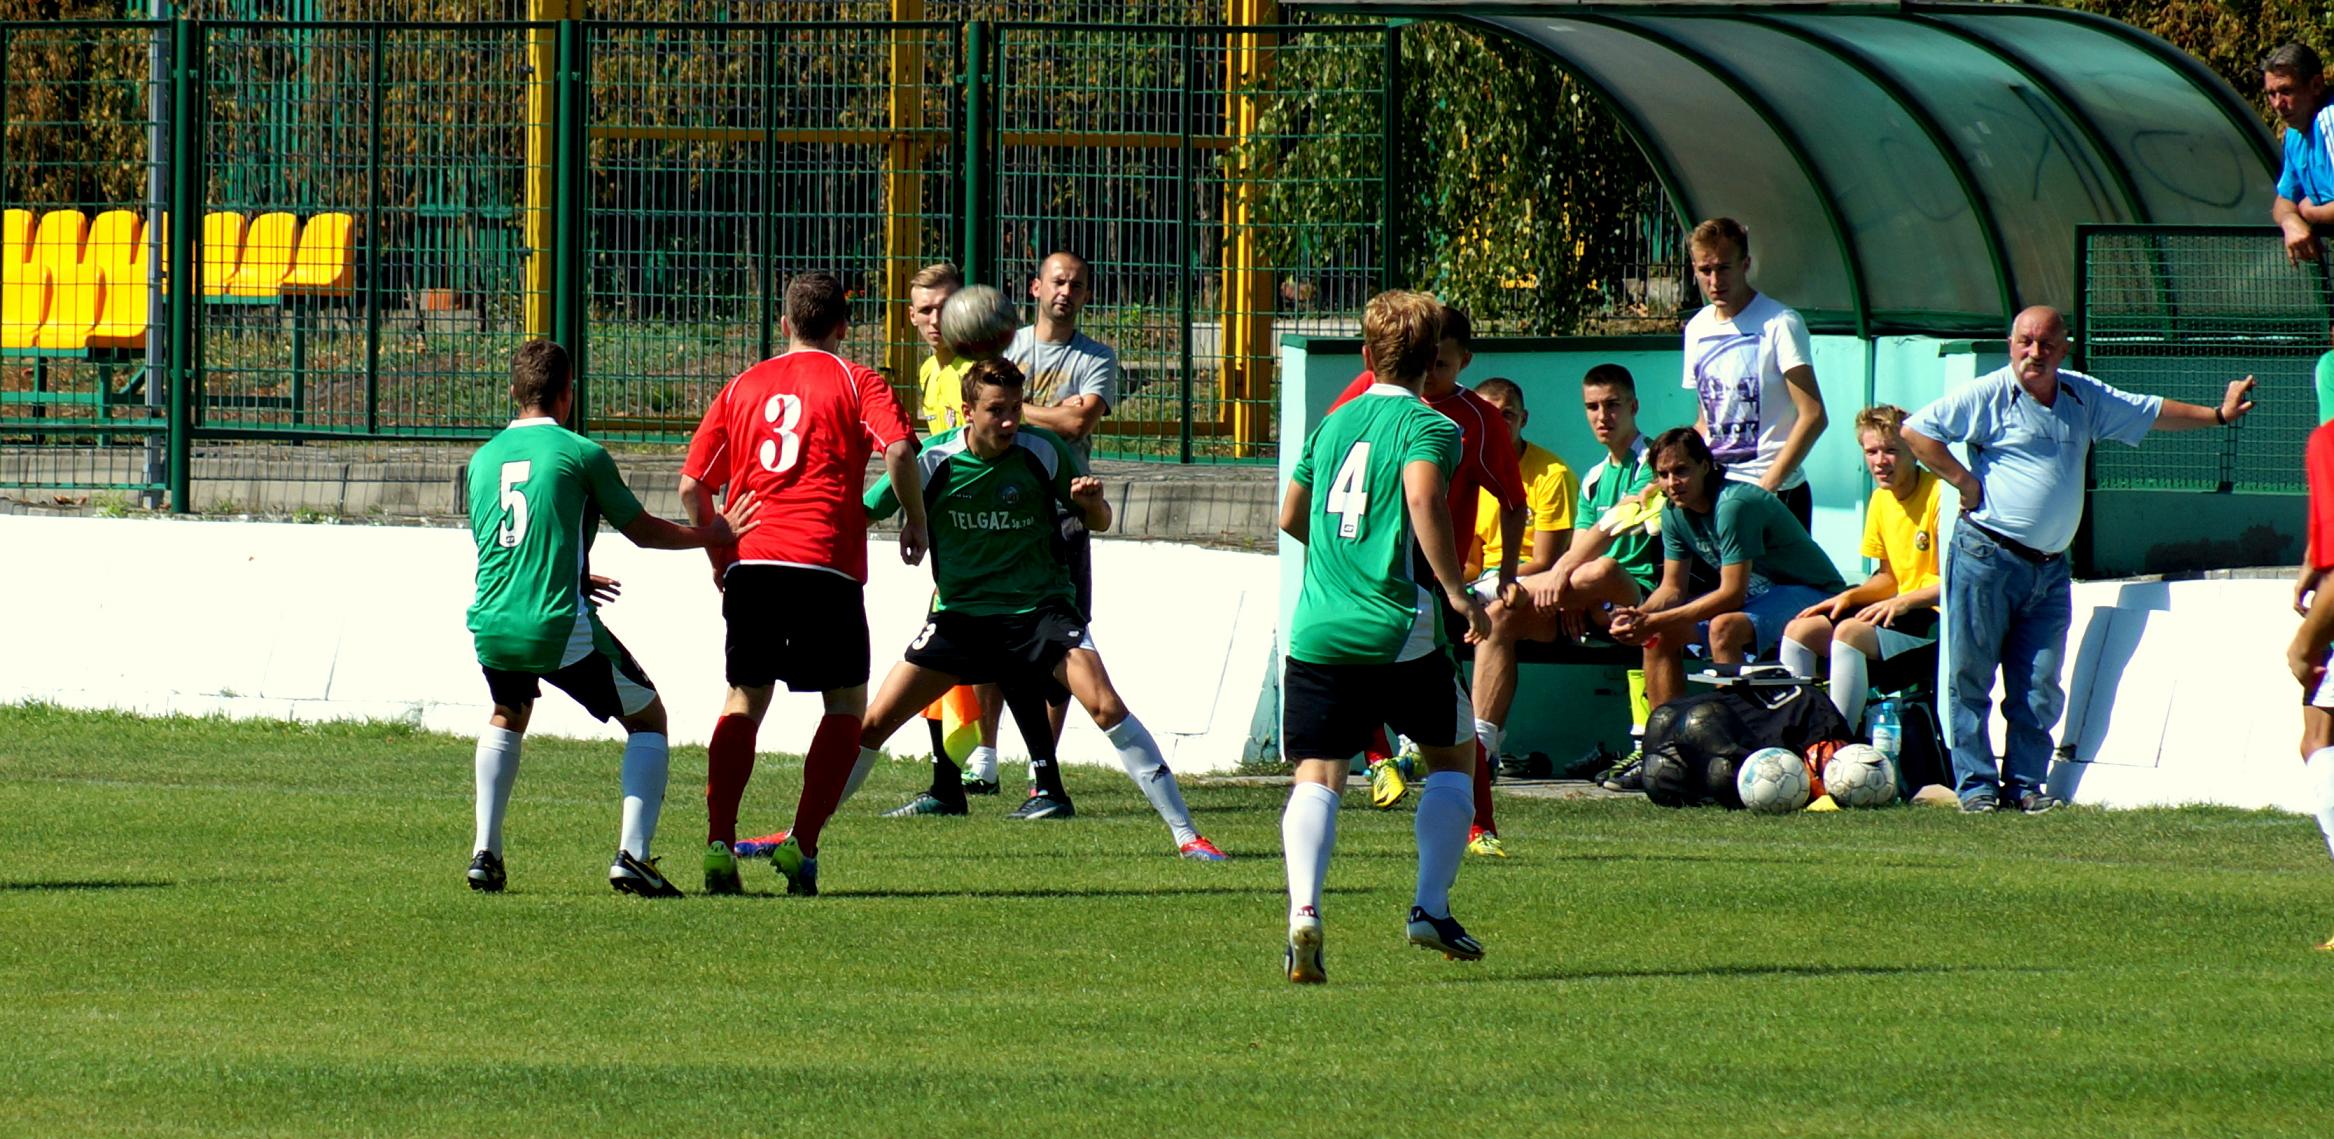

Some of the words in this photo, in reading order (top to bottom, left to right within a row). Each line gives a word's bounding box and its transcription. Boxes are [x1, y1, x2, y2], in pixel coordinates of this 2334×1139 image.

[760, 393, 802, 473] 3
[500, 460, 531, 548] 5
[948, 510, 1010, 530] TELGAZ
[1326, 441, 1371, 538] 4
[911, 622, 937, 651] 3
